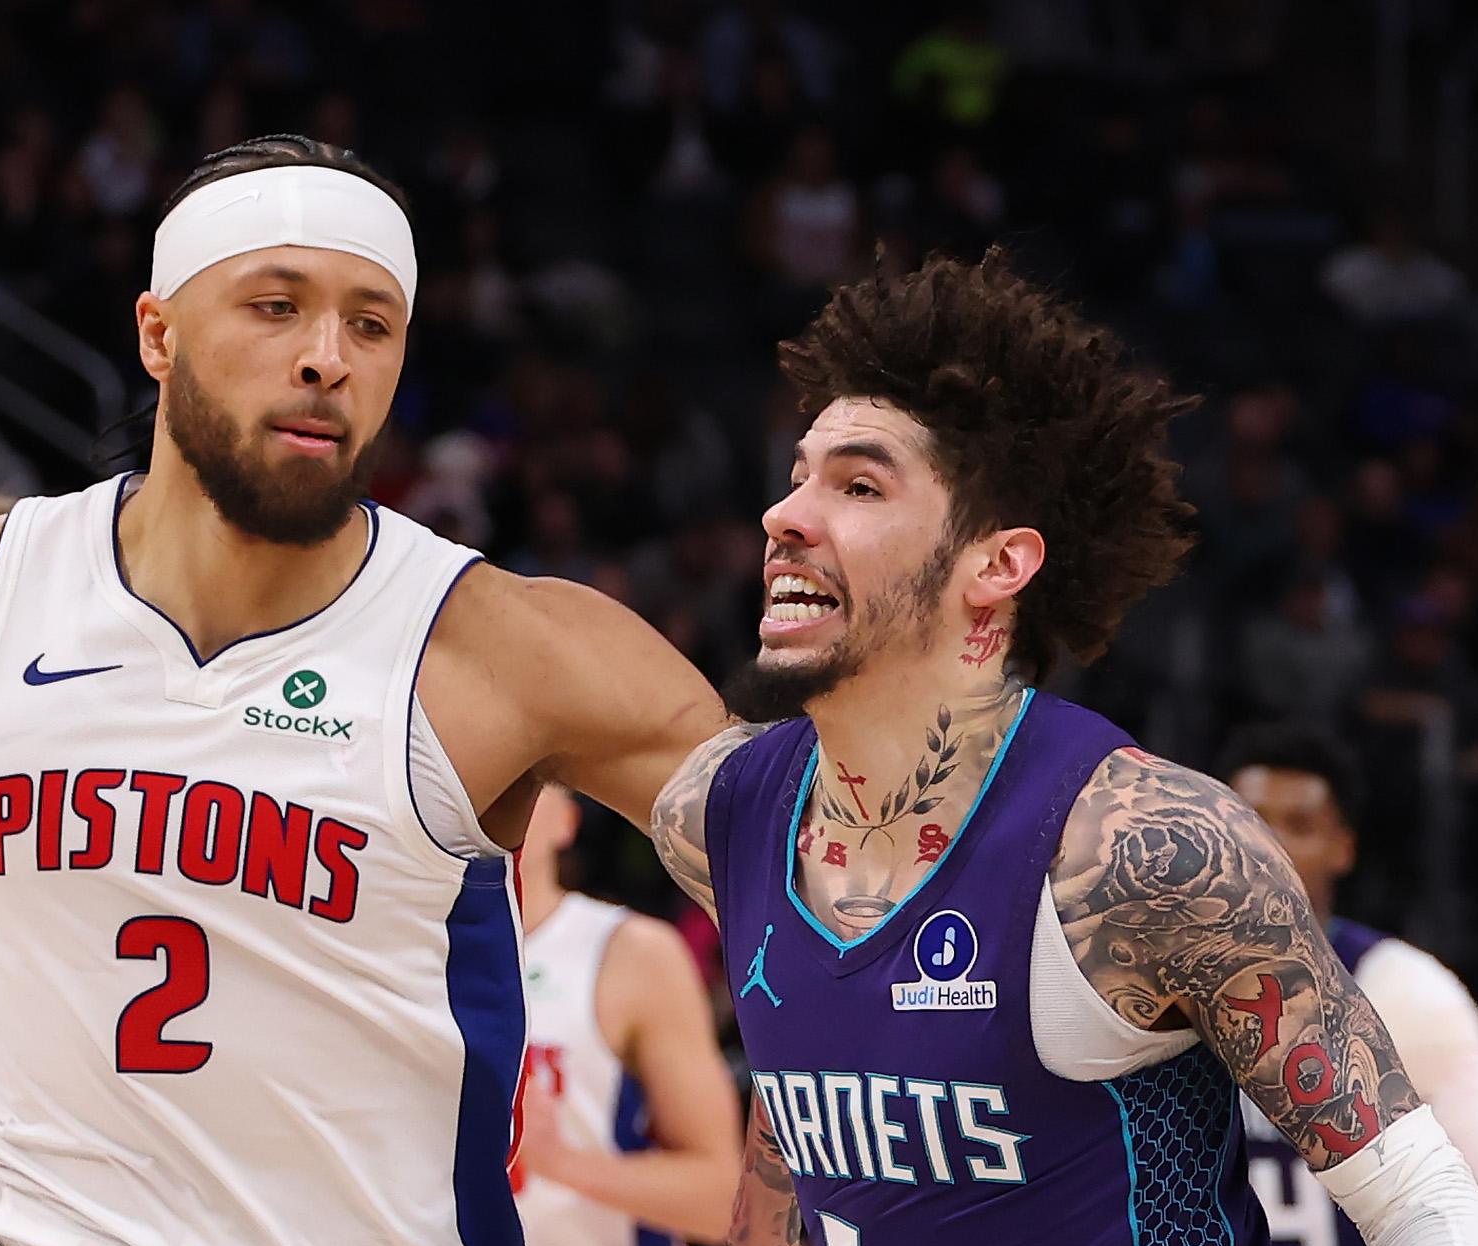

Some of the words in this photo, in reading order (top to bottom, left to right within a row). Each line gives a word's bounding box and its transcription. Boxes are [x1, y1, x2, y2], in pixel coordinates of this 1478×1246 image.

[243, 706, 353, 741] StockX
[115, 915, 213, 1074] 2
[896, 985, 935, 1006] Judi
[937, 984, 994, 1006] Health
[751, 1069, 1034, 1185] ORNETS
